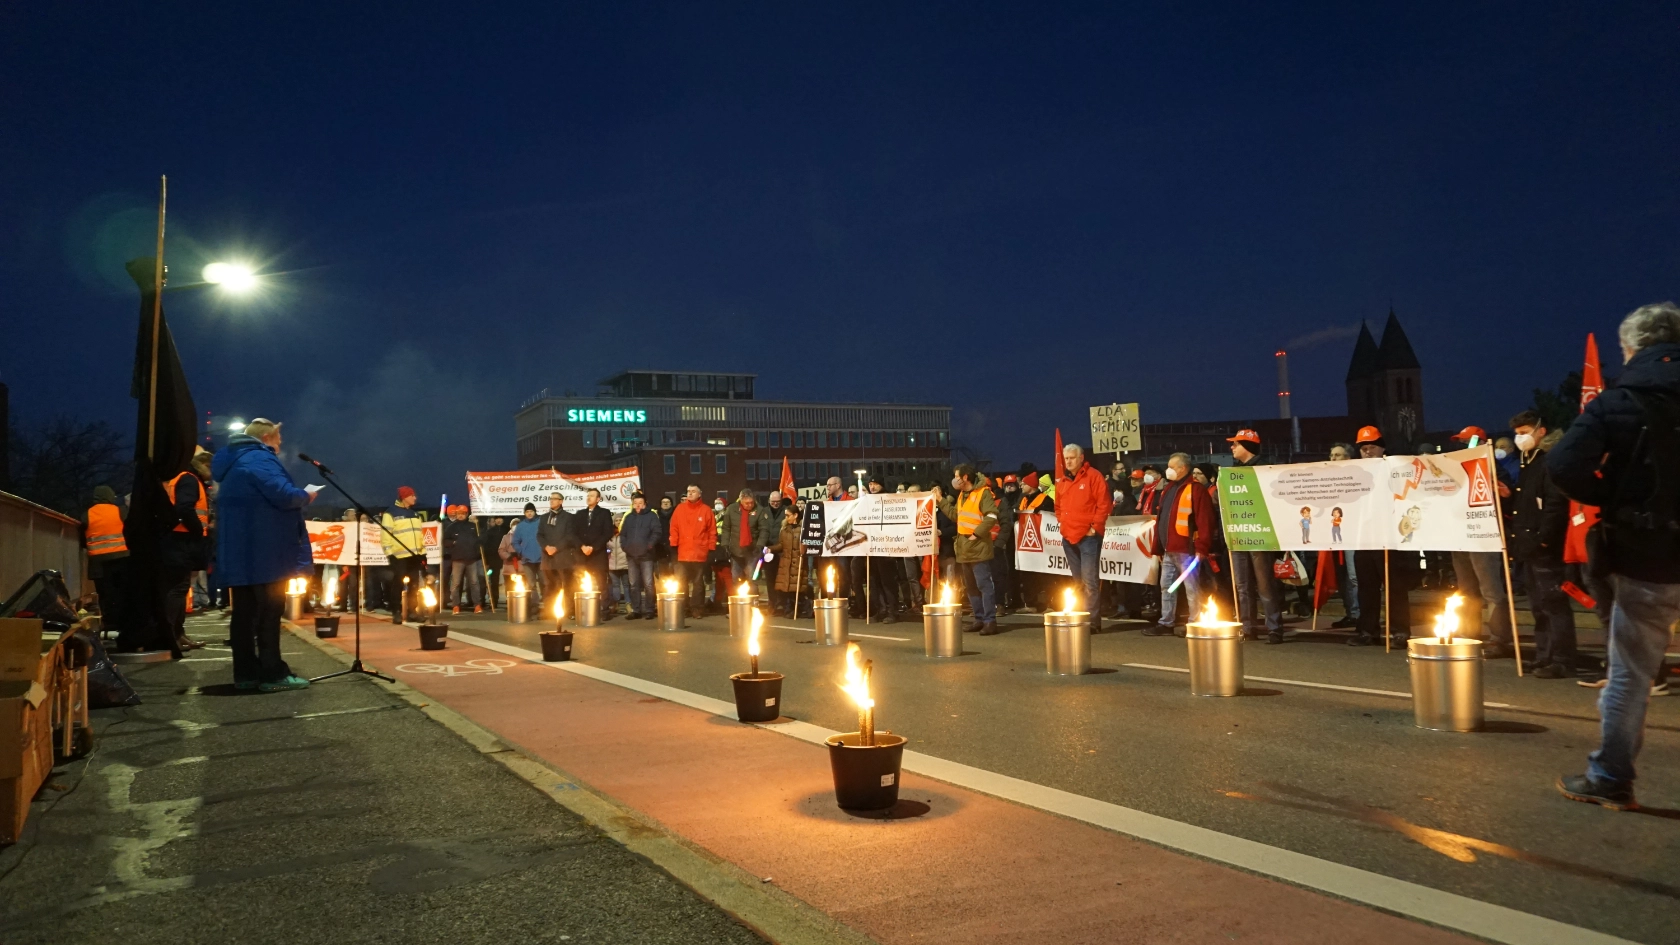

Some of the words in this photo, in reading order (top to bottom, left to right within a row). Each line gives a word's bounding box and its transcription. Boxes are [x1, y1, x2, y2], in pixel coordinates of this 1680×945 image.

[568, 409, 646, 422] SIEMENS
[1097, 405, 1123, 416] LDA
[1092, 419, 1138, 433] SIEMENS
[1100, 436, 1129, 451] NBG
[489, 485, 518, 494] Gegen
[538, 483, 586, 492] Zerschlag
[806, 488, 827, 500] LDA
[1230, 485, 1248, 494] LDA
[491, 495, 529, 503] Siemens
[1110, 542, 1130, 550] Metall
[1232, 537, 1264, 546] bleiben
[1100, 557, 1132, 576] ÜRTH
